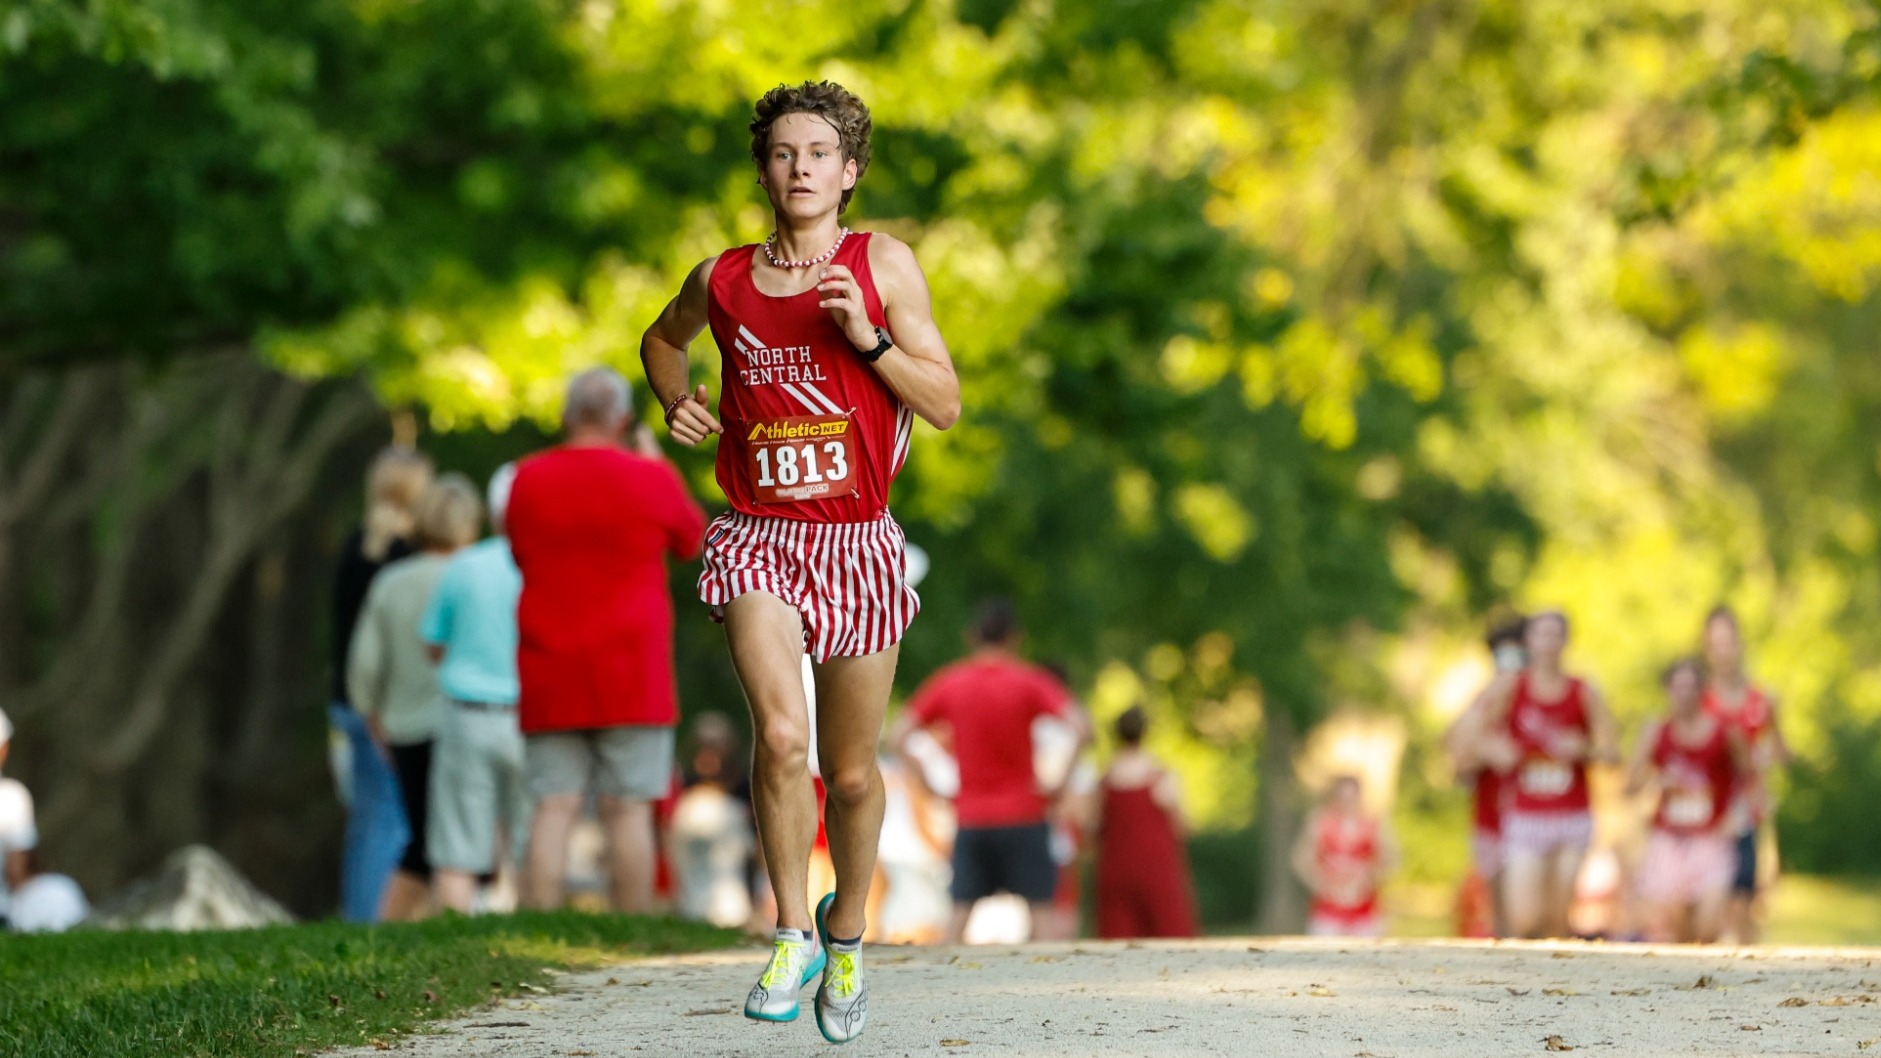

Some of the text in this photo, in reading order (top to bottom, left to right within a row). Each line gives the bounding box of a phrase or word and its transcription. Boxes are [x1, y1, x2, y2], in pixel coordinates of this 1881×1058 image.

[746, 346, 811, 367] NORTH
[741, 366, 826, 385] CENTRAL
[757, 442, 847, 486] 1813
